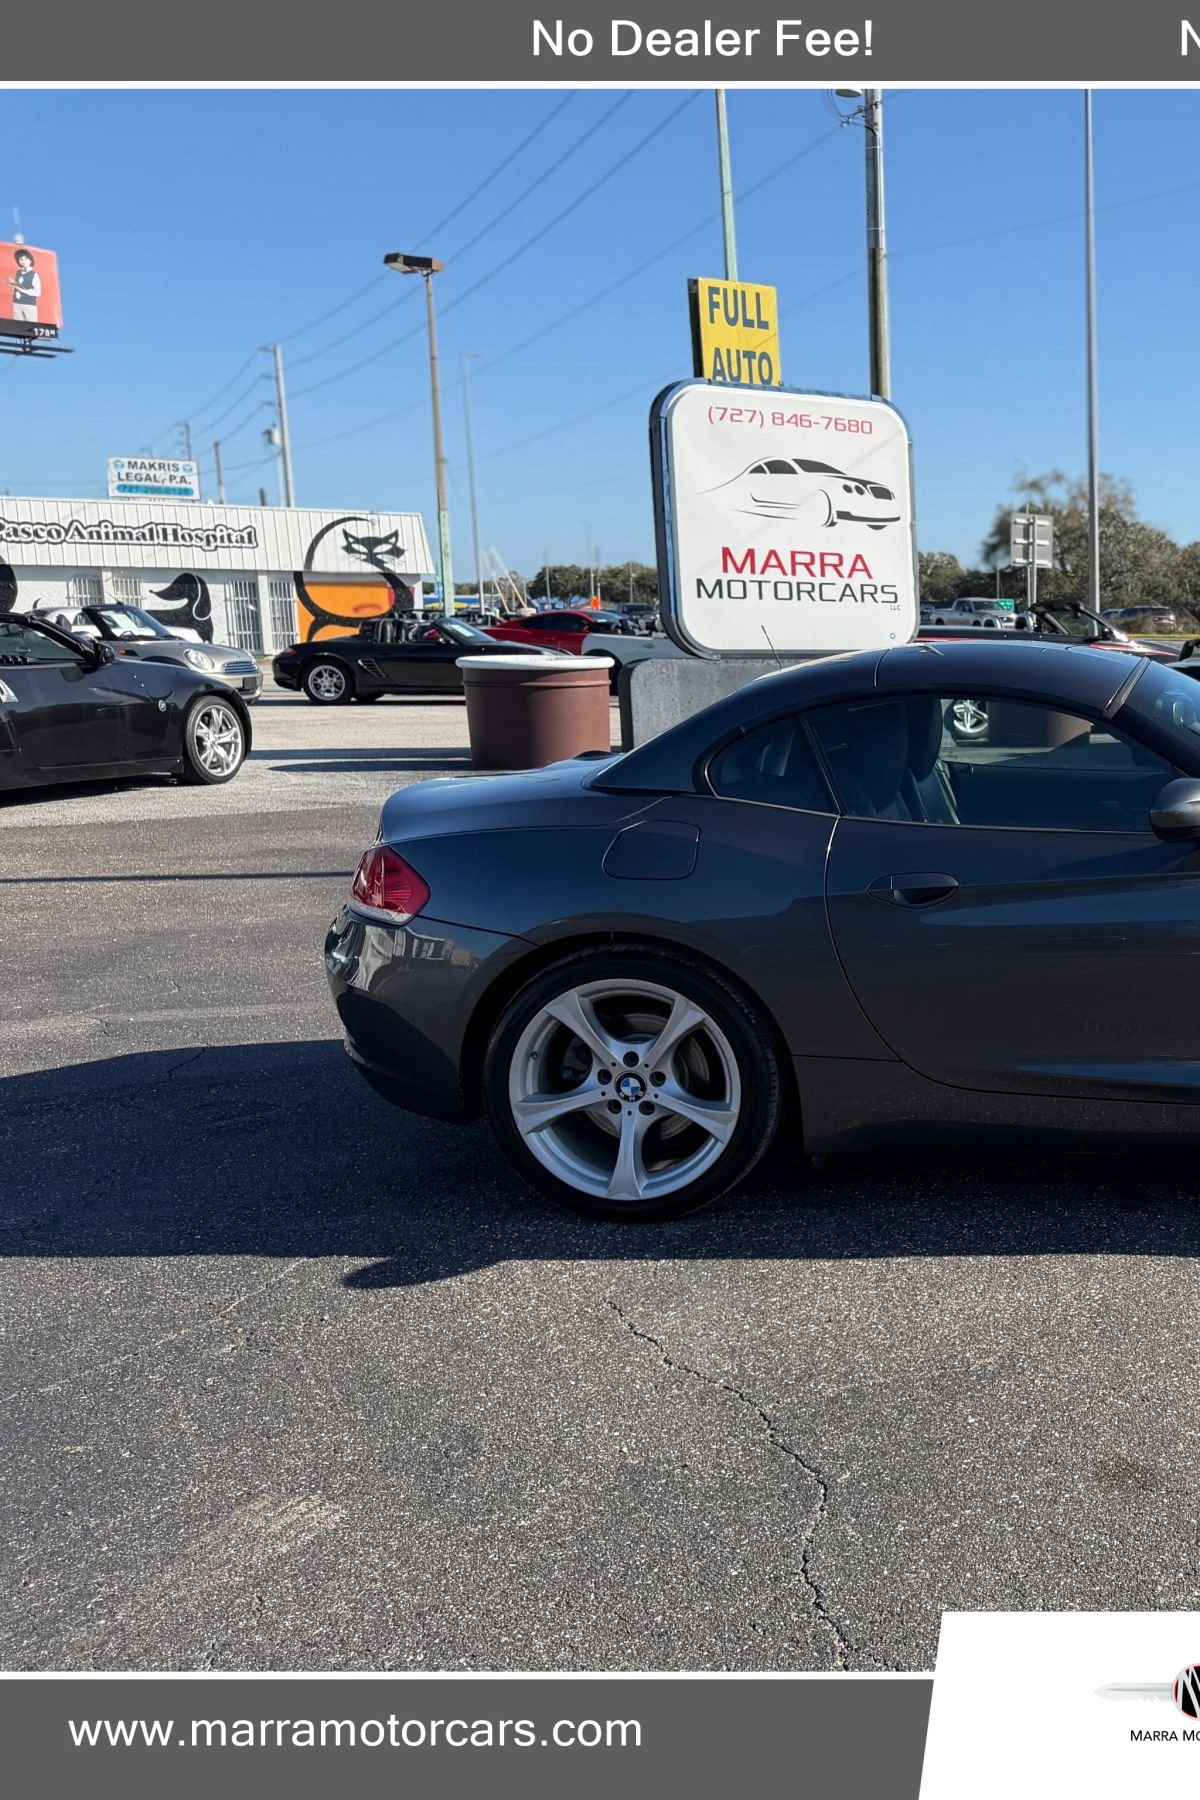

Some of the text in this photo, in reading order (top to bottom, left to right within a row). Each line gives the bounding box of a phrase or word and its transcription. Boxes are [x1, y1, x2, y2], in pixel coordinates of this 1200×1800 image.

[707, 285, 770, 331] FULL
[712, 346, 774, 386] AUTO
[707, 405, 873, 435] (727) 846-7680
[127, 460, 180, 473] MAKRIS
[168, 474, 192, 486] P.A.
[68, 520, 156, 544] Animal
[157, 523, 257, 550] Hospital
[721, 546, 874, 580] MARRA
[696, 577, 899, 604] MOTORCARS
